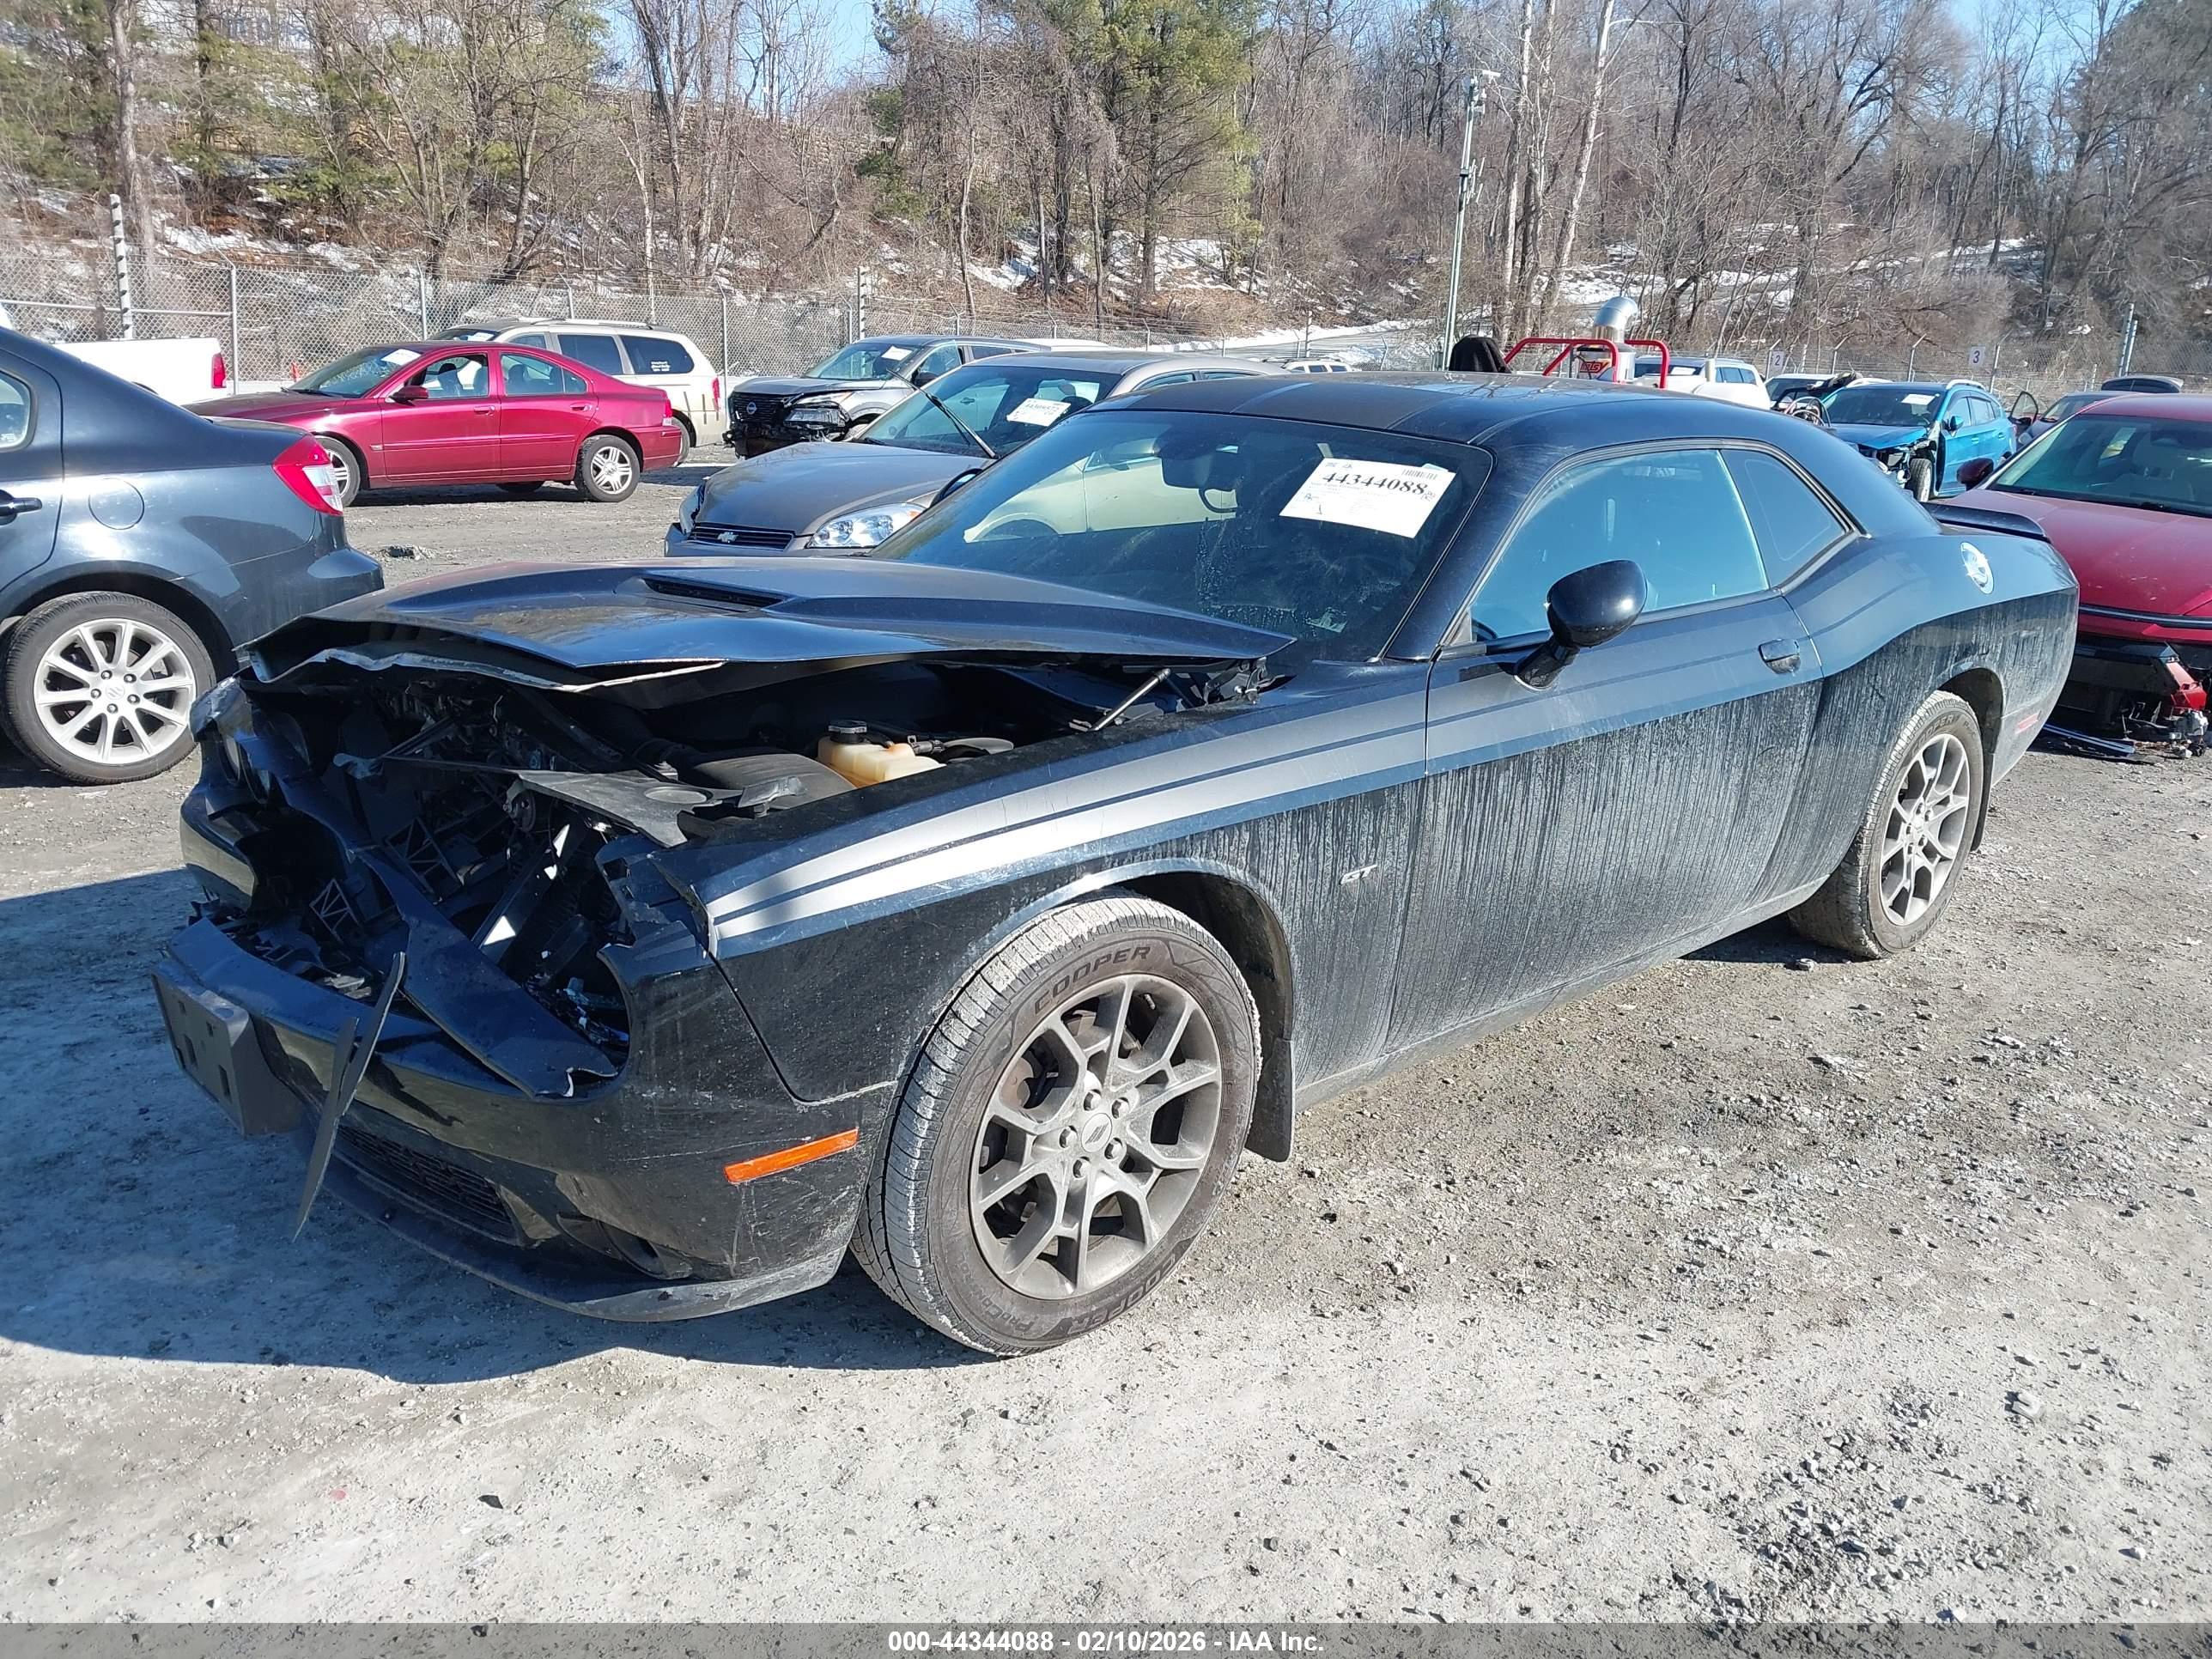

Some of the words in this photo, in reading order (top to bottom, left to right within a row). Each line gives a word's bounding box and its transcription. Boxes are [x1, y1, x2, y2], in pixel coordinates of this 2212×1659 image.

[1775, 354, 1781, 366] 2
[1972, 349, 1980, 364] 3
[1322, 472, 1428, 495] 44344088
[1034, 946, 1151, 1014] COOPER
[1067, 1254, 1176, 1334] COOPER
